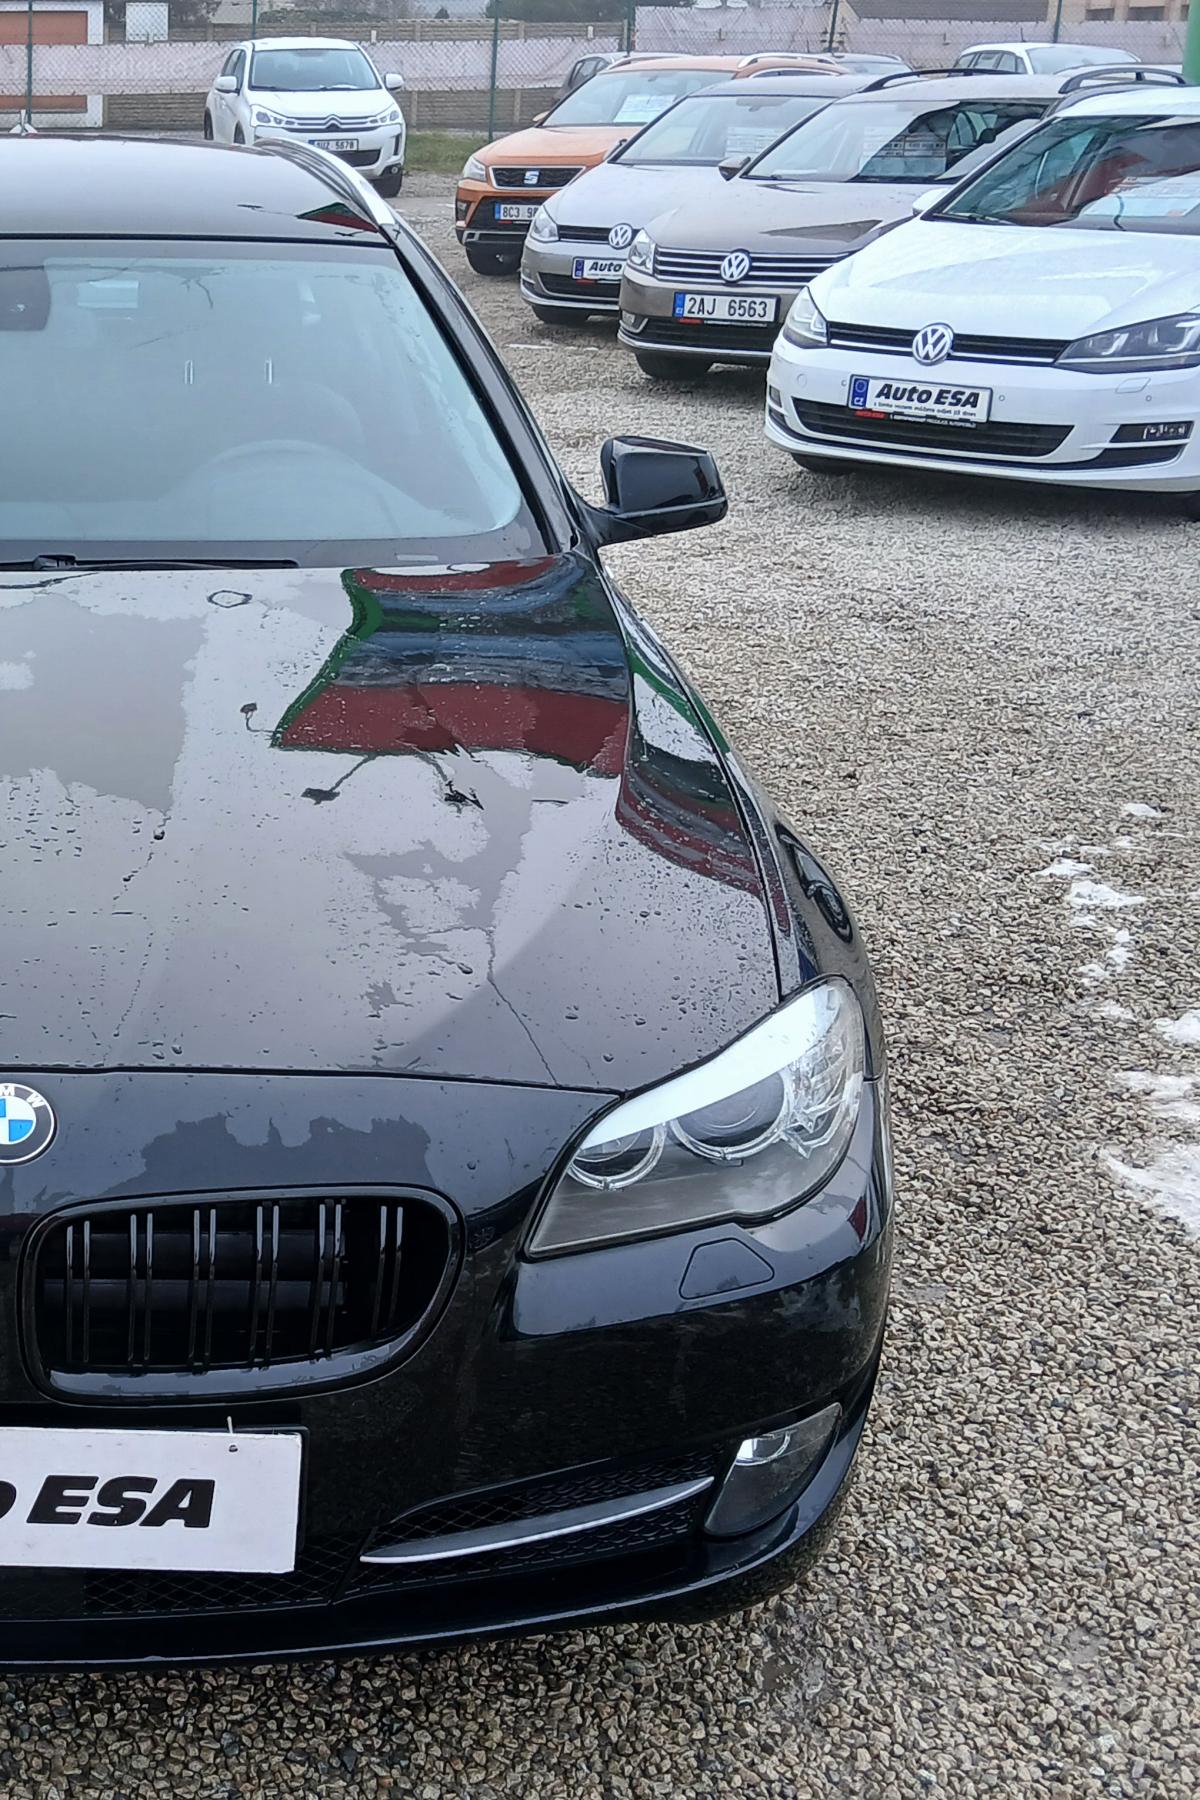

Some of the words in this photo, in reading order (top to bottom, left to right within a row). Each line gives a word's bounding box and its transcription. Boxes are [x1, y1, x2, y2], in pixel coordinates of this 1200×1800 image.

[588, 261, 623, 272] Auto
[687, 297, 716, 316] 2AJ
[728, 299, 768, 318] 6563
[874, 383, 933, 404] Auto
[933, 388, 980, 409] ESA
[26, 1474, 217, 1529] ESA
